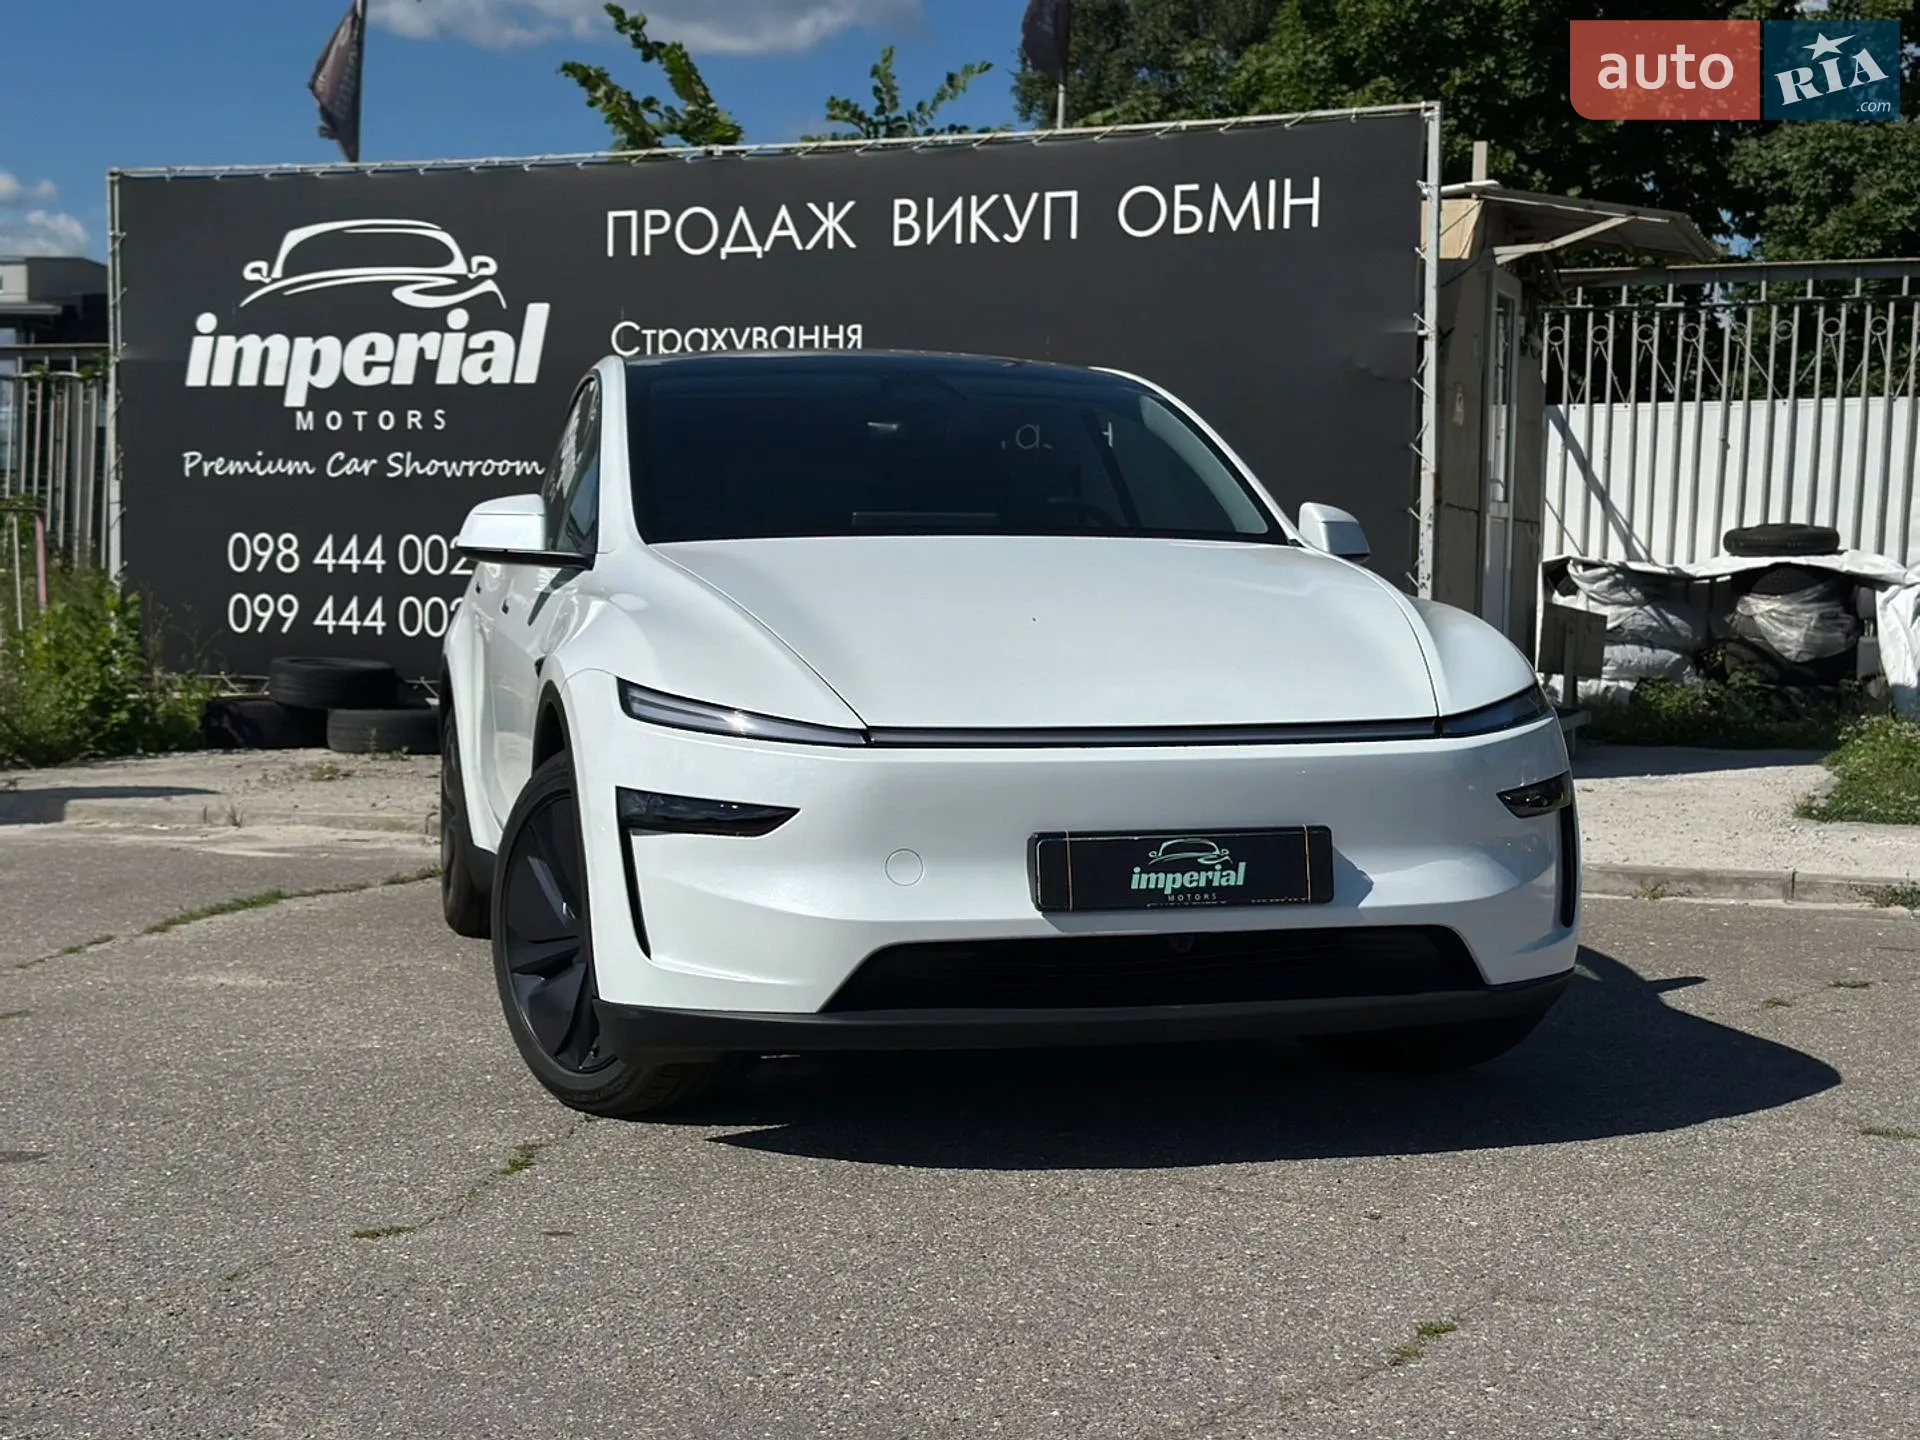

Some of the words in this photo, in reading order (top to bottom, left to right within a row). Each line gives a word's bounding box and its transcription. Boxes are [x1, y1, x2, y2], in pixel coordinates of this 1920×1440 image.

[606, 200, 857, 260] ПРОДАЖ
[892, 189, 1079, 247] ВИКУП
[1117, 176, 1321, 238] ОБМІН
[185, 302, 550, 408] imperial
[611, 320, 863, 356] Страхування
[295, 409, 447, 431] MOTORS
[182, 450, 316, 478] Premium
[325, 450, 377, 478] Car
[386, 450, 546, 478] Showroom
[227, 532, 300, 574] 098
[312, 533, 387, 574] 444
[227, 592, 300, 634] 099
[312, 594, 387, 635] 444
[1130, 861, 1247, 895] imperial
[1167, 892, 1218, 902] MOTORS
